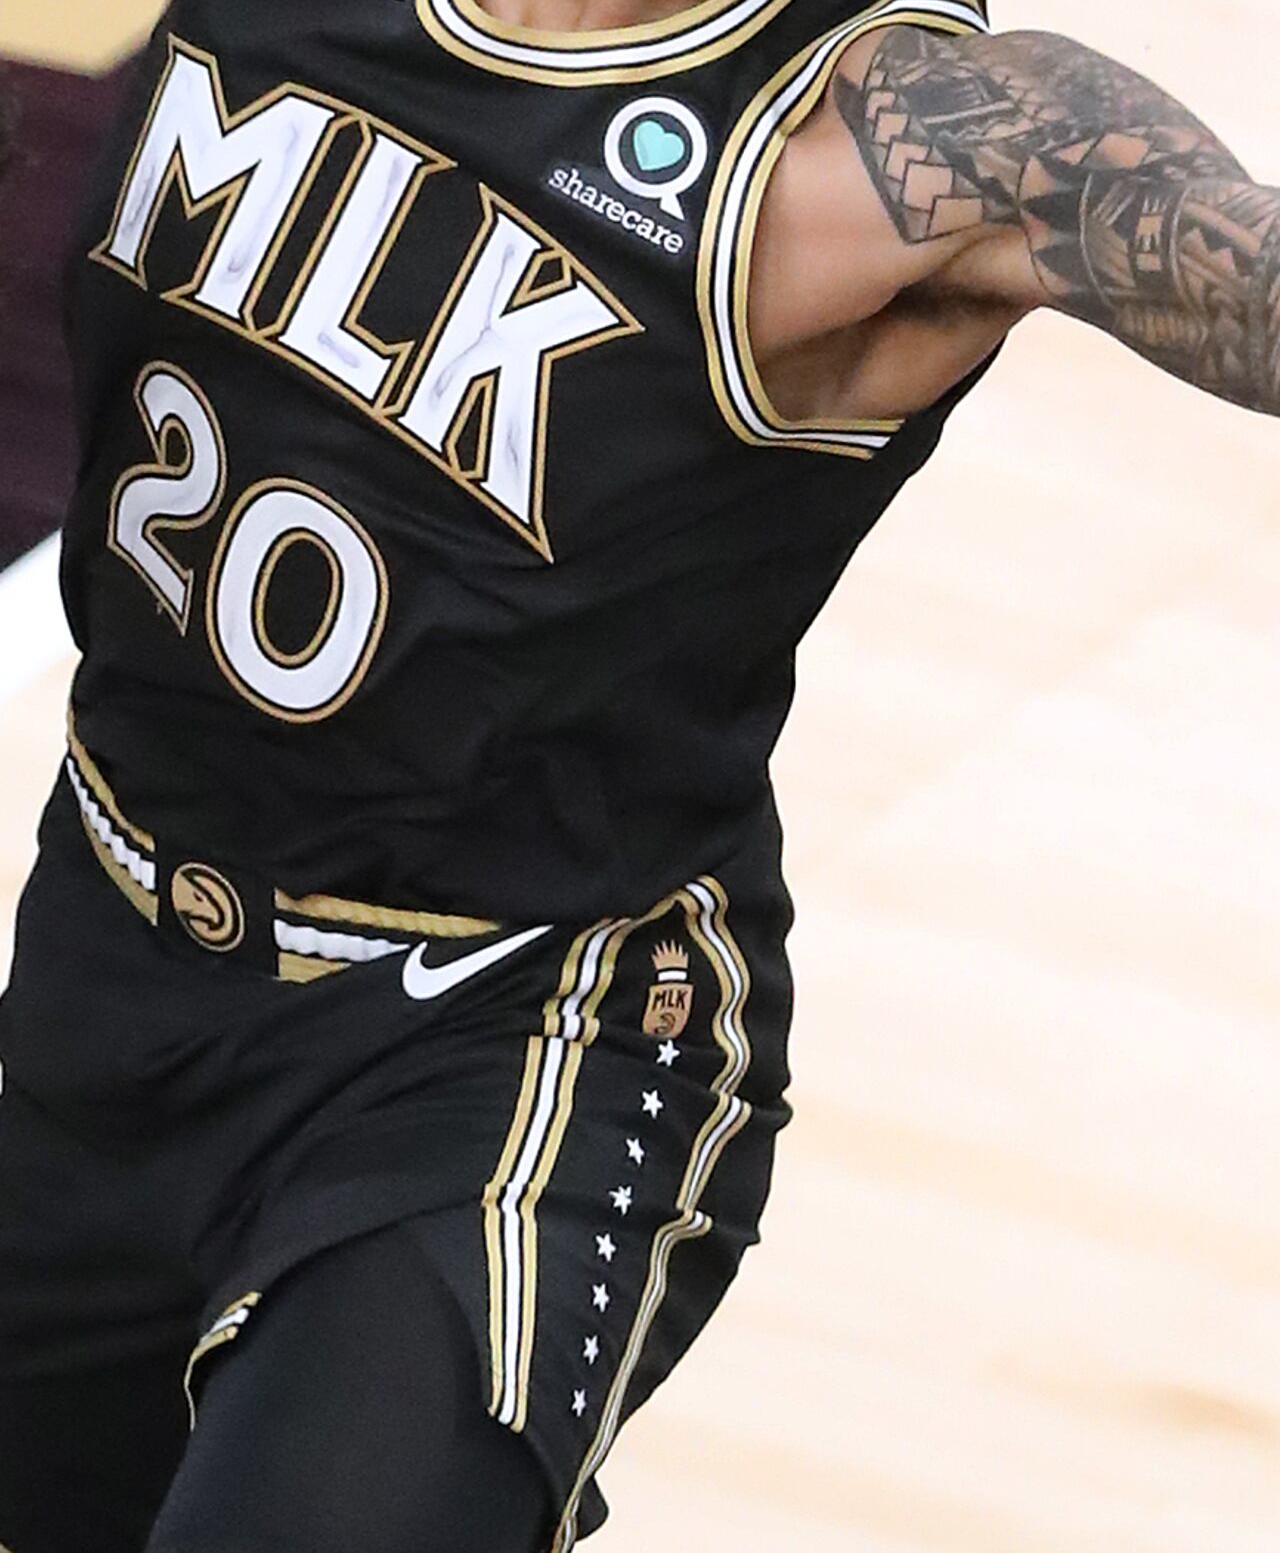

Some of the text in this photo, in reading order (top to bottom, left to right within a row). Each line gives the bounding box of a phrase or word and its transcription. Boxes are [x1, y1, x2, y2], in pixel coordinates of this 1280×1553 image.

[88, 32, 646, 565] MLK
[547, 167, 684, 254] sharecare
[107, 360, 390, 724] 20
[652, 989, 689, 1011] MLK
